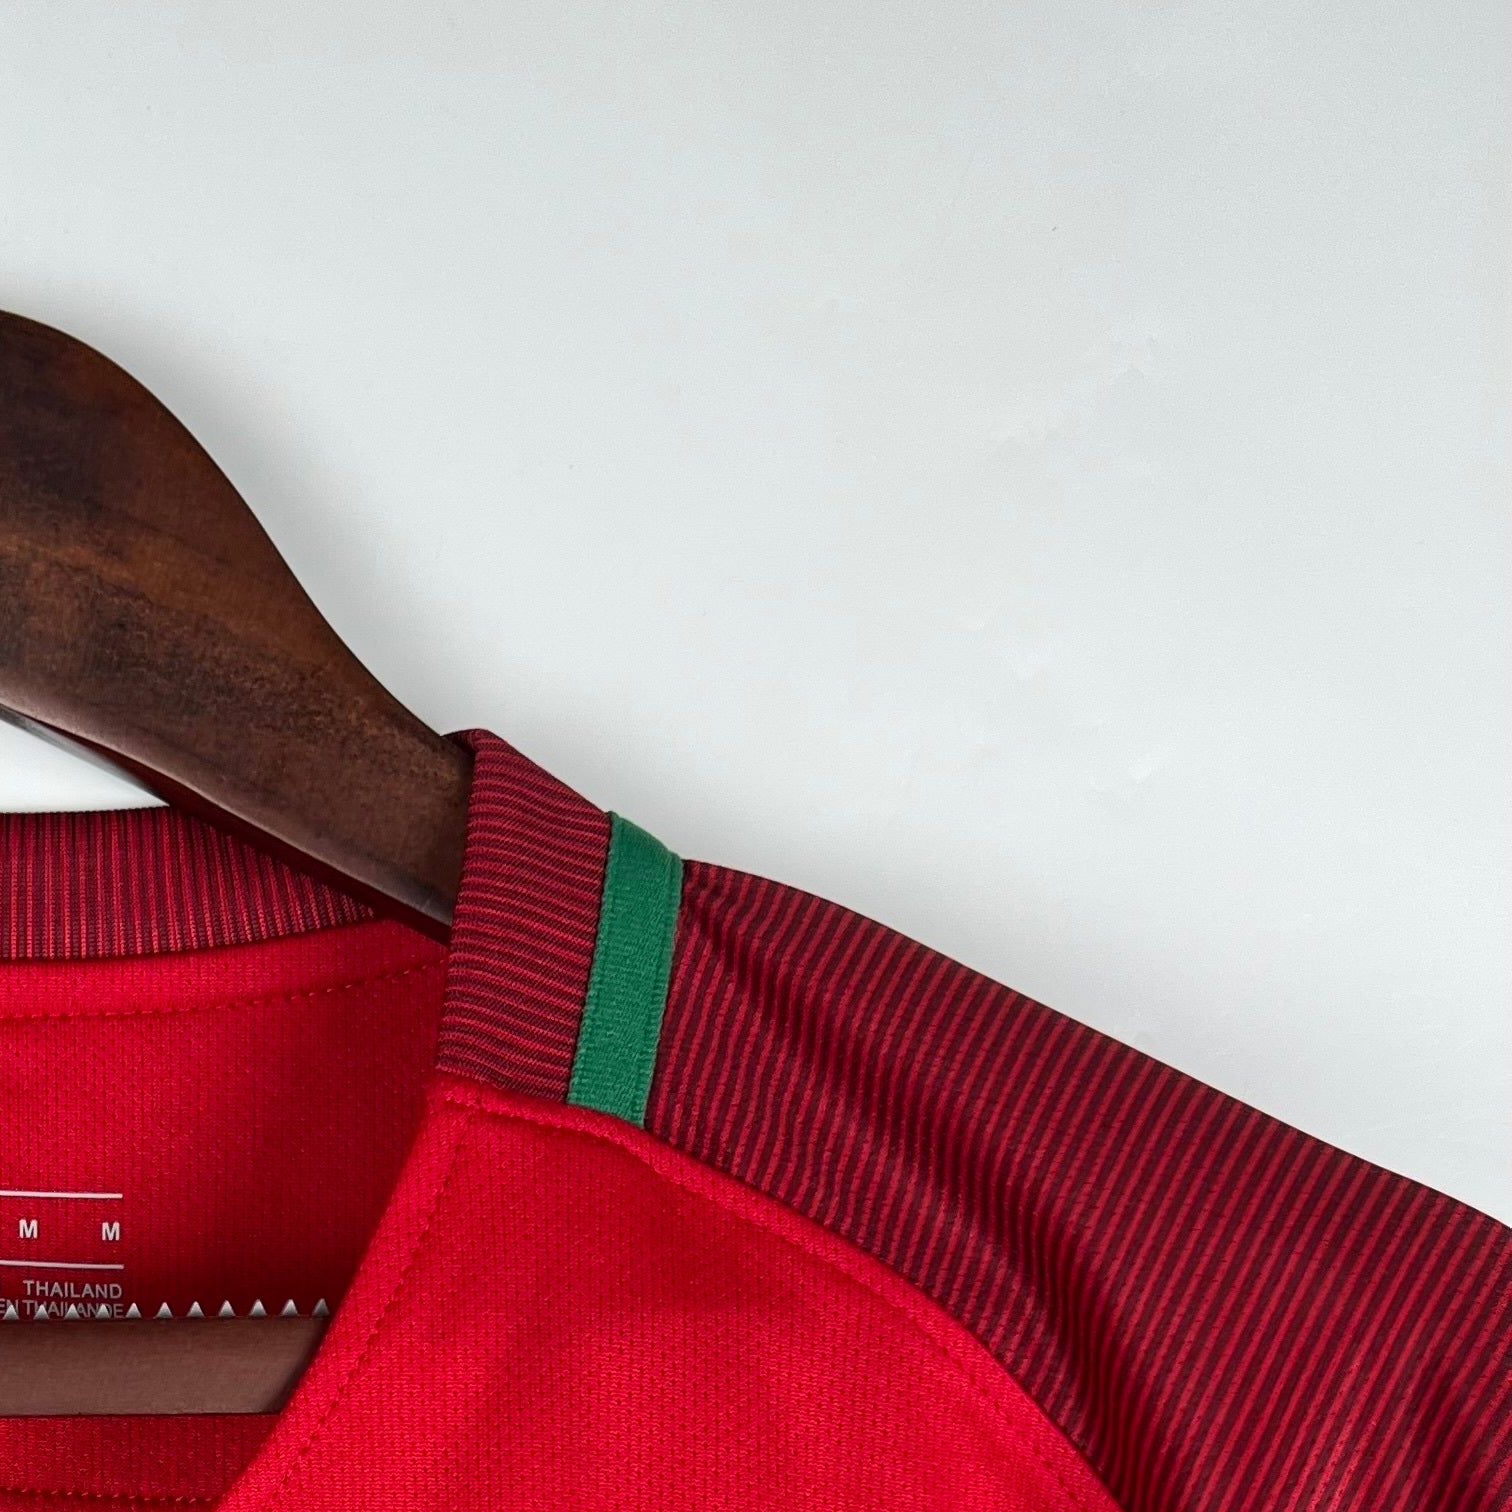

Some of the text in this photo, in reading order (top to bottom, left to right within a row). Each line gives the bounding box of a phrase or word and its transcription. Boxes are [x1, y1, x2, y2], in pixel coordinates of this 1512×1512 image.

[18, 1218, 38, 1239] M
[101, 1221, 121, 1241] M
[23, 1280, 123, 1299] THAILAND
